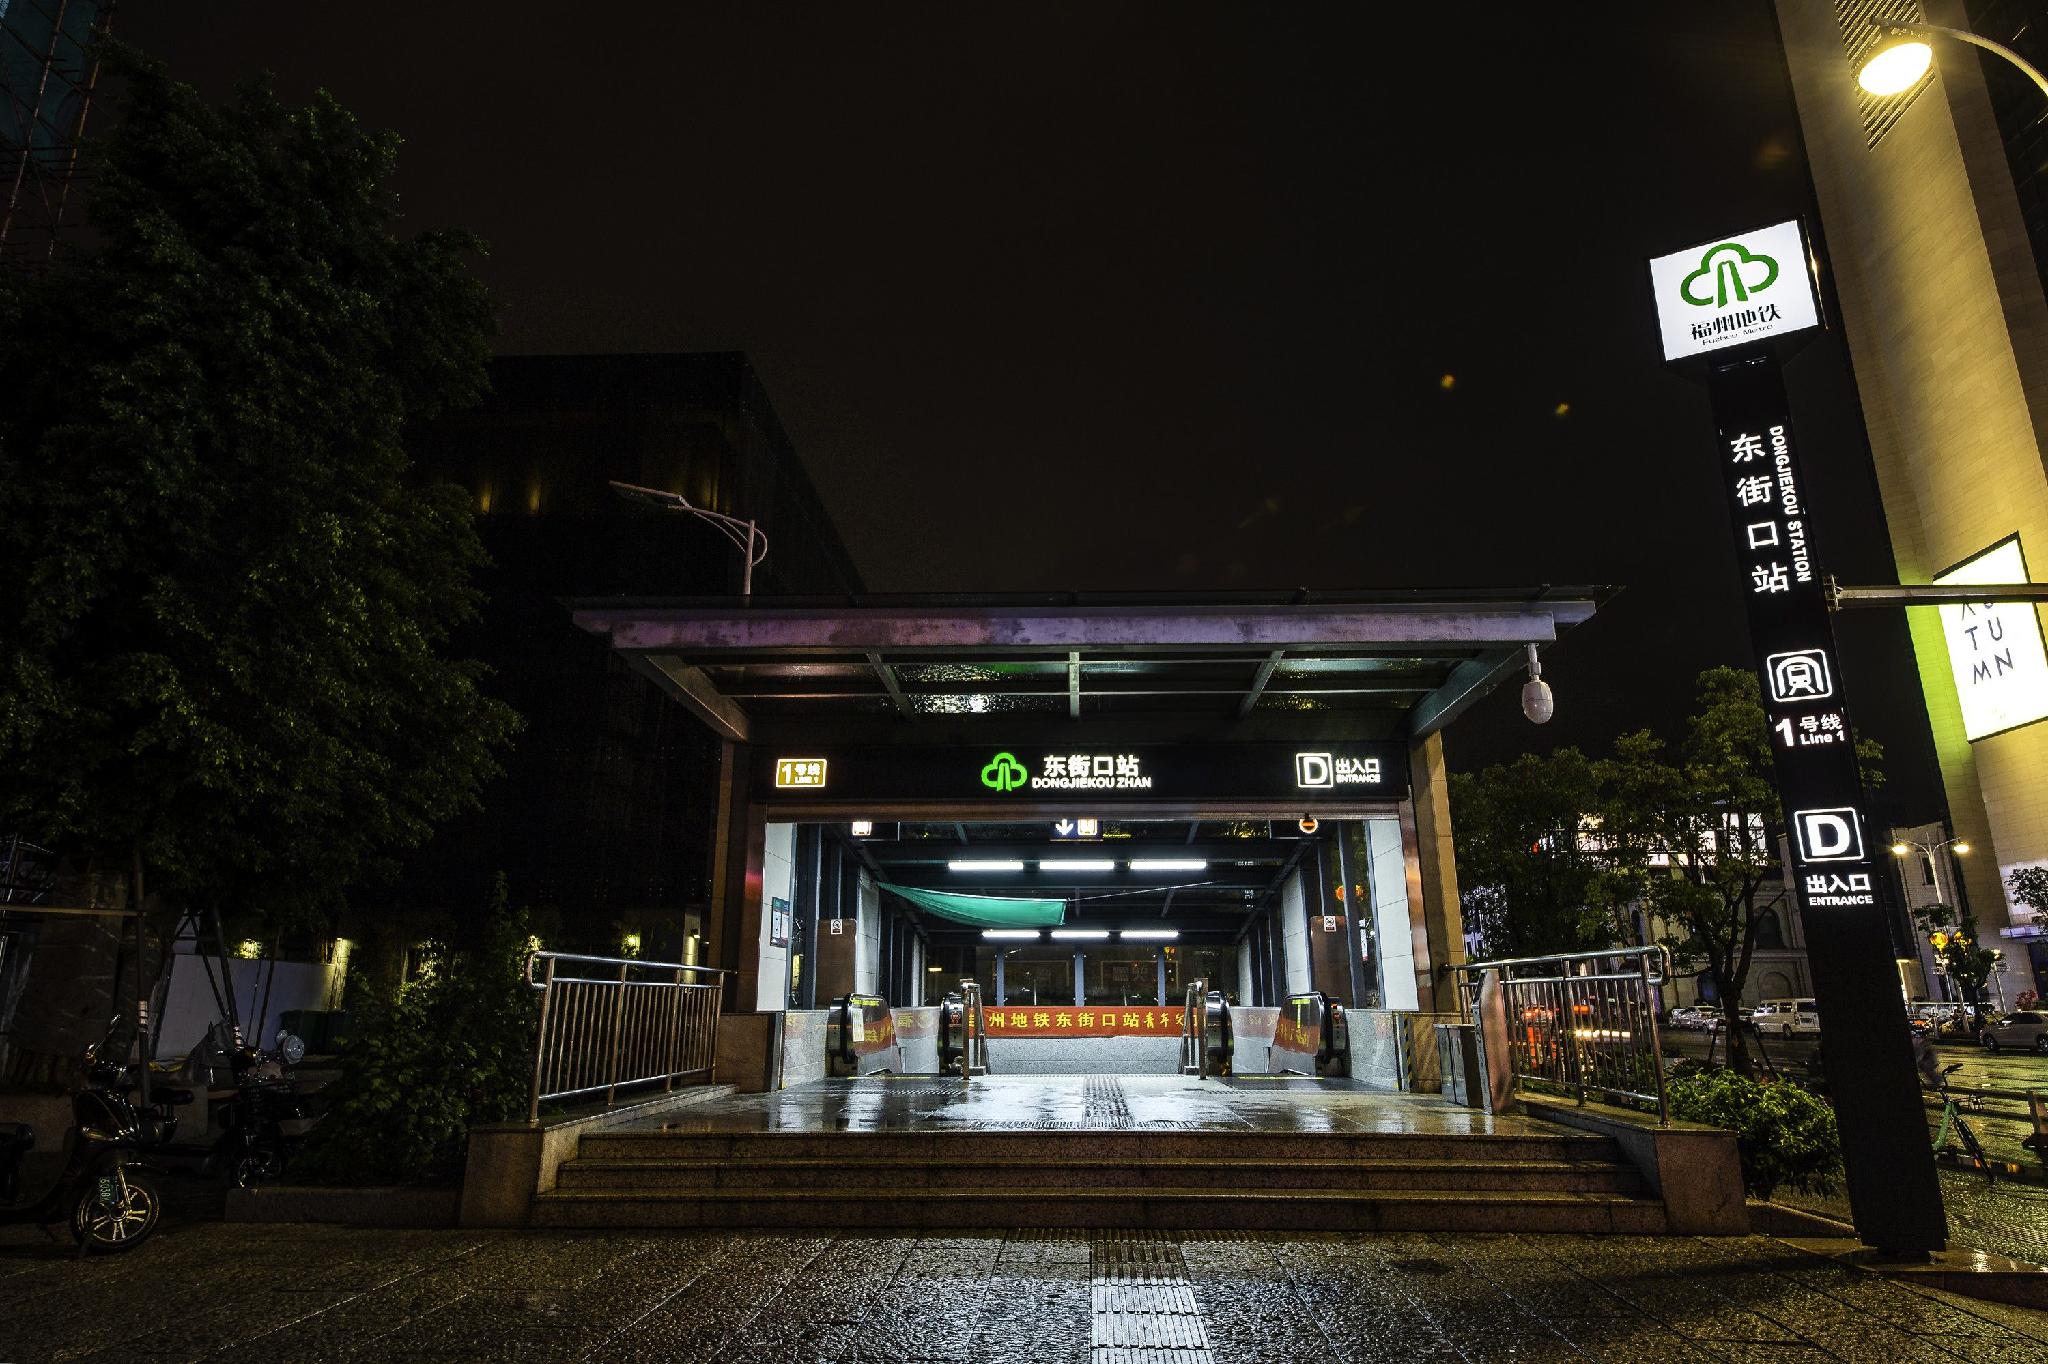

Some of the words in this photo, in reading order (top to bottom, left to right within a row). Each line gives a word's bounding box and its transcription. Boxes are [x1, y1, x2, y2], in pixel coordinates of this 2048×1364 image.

[1691, 303, 1782, 340] 福州地铁
[1730, 433, 1790, 594] 东街口站
[1769, 425, 1799, 515] DONGJIEKOU
[1787, 520, 1812, 582] STATION
[1799, 713, 1843, 733] 号线
[1800, 734, 1833, 746] Line
[1836, 730, 1845, 742] 1
[1043, 754, 1140, 777] 东街口站
[1303, 756, 1328, 785] D
[1335, 758, 1380, 773] 出入口
[1032, 777, 1115, 789] DONGJIEKOU
[1116, 777, 1152, 789] ZHAN
[1335, 773, 1381, 784] ENTRANCE
[1805, 814, 1850, 857] D
[1805, 873, 1872, 894] 出入口
[1808, 894, 1874, 907] ENTRANCE
